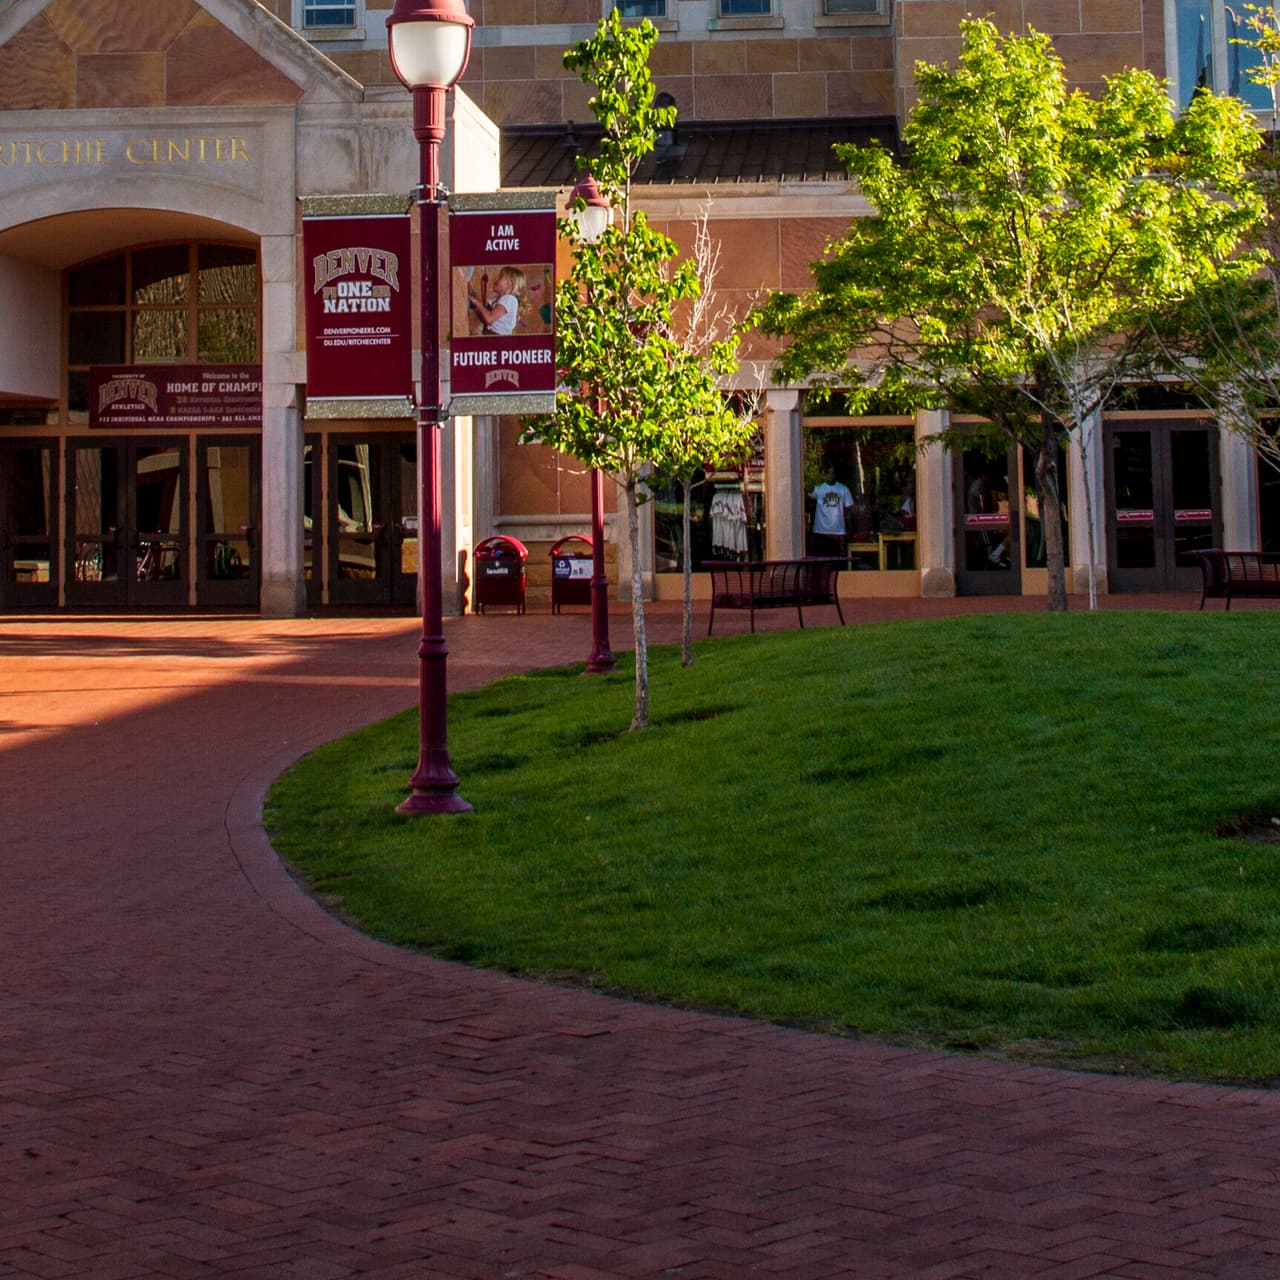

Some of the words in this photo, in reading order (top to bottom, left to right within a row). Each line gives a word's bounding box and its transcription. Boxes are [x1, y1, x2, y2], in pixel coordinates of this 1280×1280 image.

[126, 136, 251, 164] CENTER
[491, 225, 495, 237] I
[497, 225, 514, 237] AM
[485, 239, 519, 251] ACTIVE
[313, 247, 399, 295] DENVER
[337, 281, 372, 297] ONE
[323, 298, 391, 313] NATION
[323, 327, 391, 335] DENVERPIONEERS.COM
[454, 351, 497, 367] FUTURE
[501, 350, 552, 366] PIONEER
[484, 369, 520, 389] DENVER
[167, 382, 199, 393] HOME
[202, 382, 216, 392] OF
[219, 382, 263, 392] CHAMPI
[98, 379, 158, 414] DENVER
